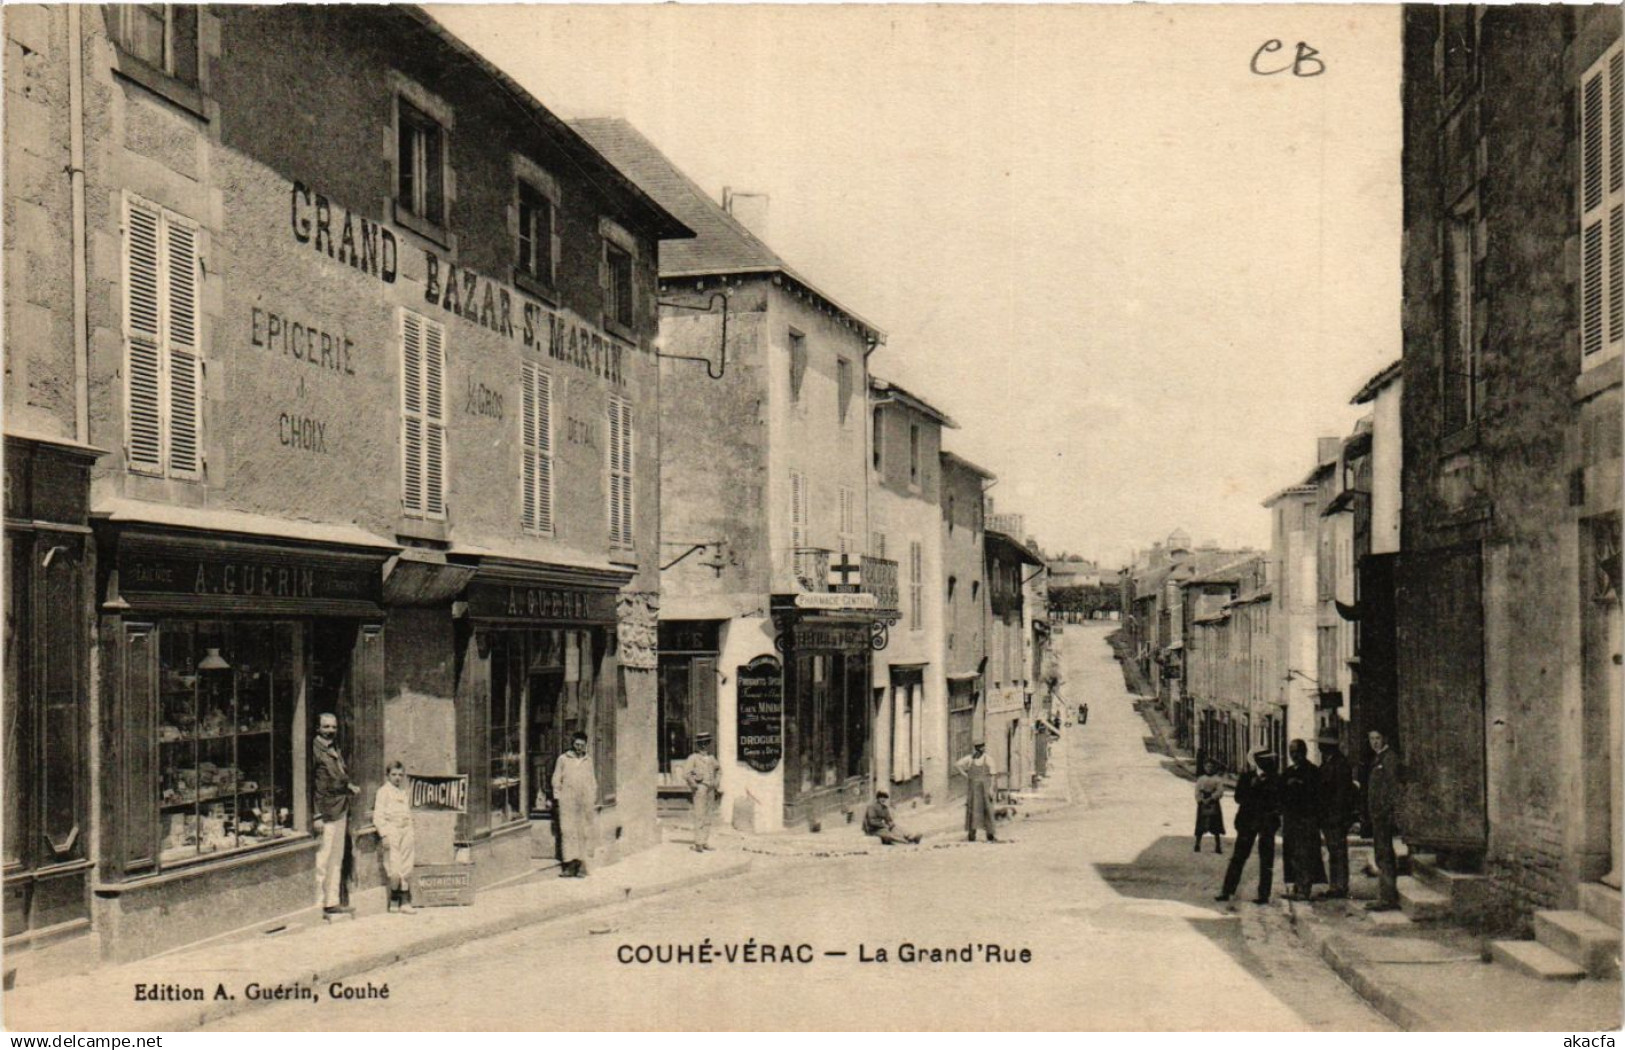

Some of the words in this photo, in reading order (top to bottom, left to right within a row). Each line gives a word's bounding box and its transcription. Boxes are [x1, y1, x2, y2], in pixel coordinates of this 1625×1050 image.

[292, 181, 397, 284] GRAND
[425, 250, 514, 339] BAZAR
[251, 294, 356, 376] ÉPICERIE
[478, 382, 504, 421] GROS
[279, 412, 328, 453] CHOIX
